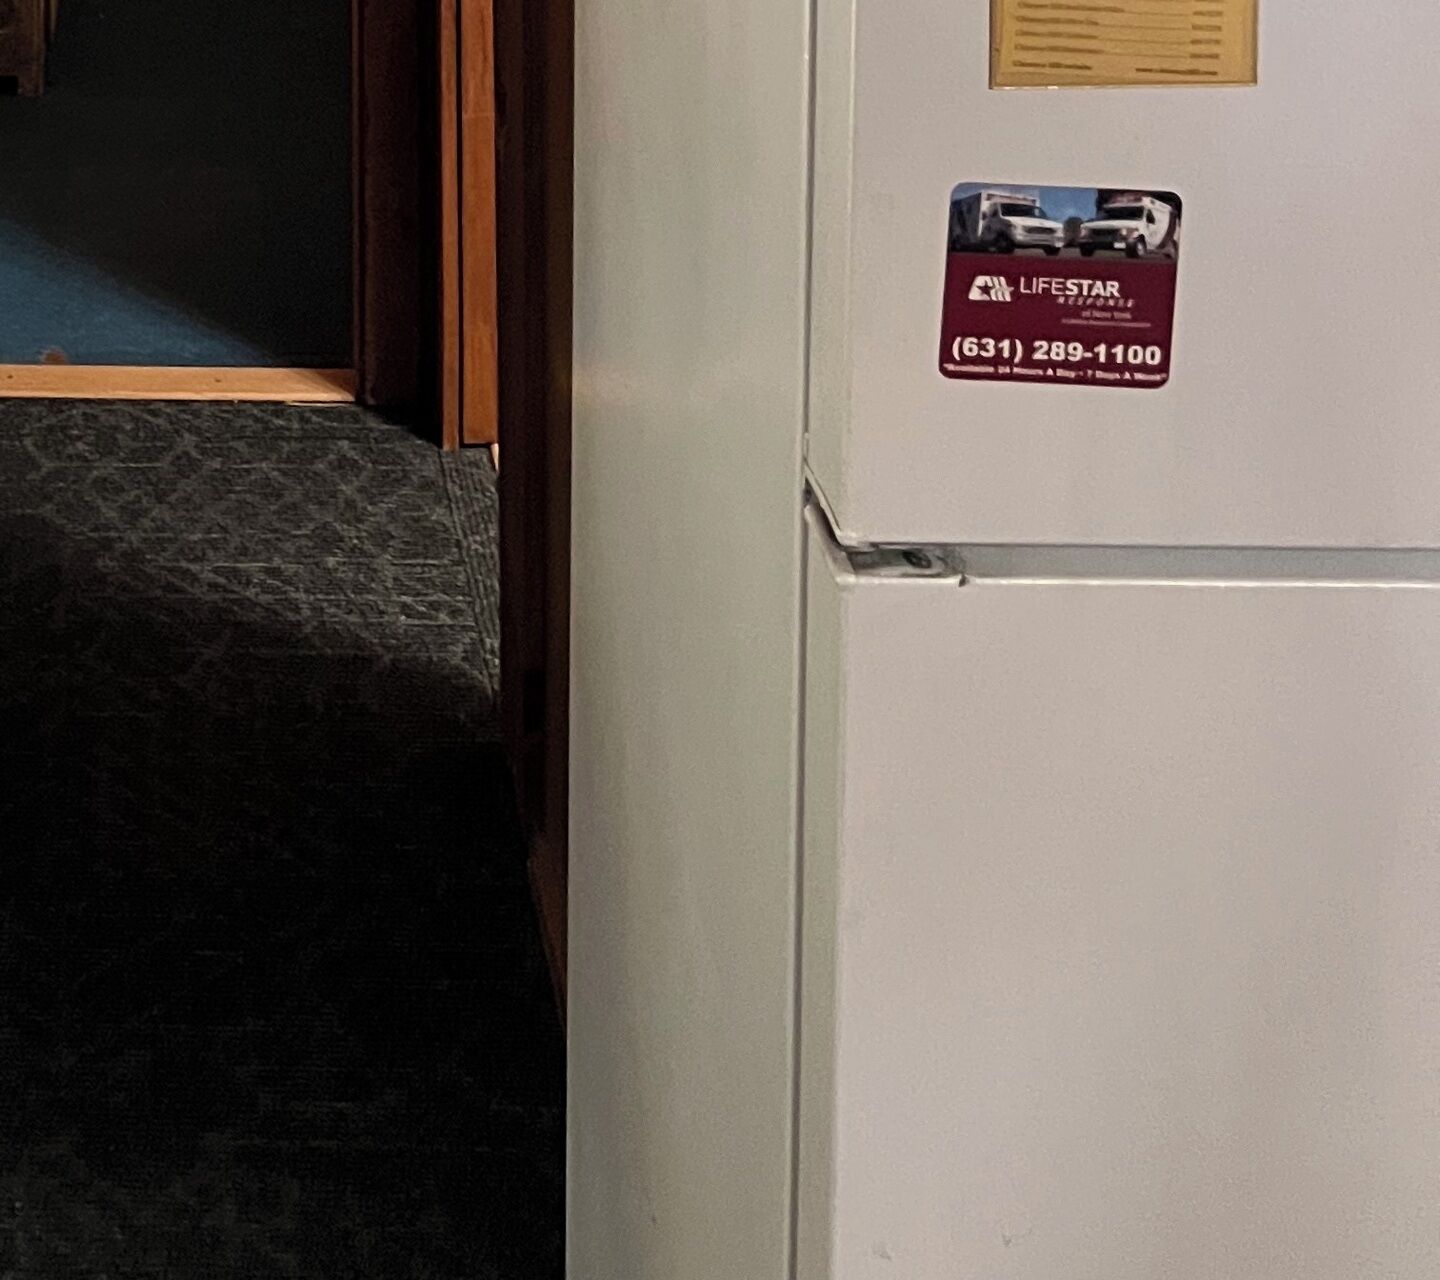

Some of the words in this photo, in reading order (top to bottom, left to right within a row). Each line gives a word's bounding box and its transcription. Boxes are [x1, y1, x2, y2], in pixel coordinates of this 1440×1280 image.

[1019, 276, 1121, 298] LIFESTAR
[951, 337, 1023, 364] (631)
[1032, 340, 1162, 366] 289-1100
